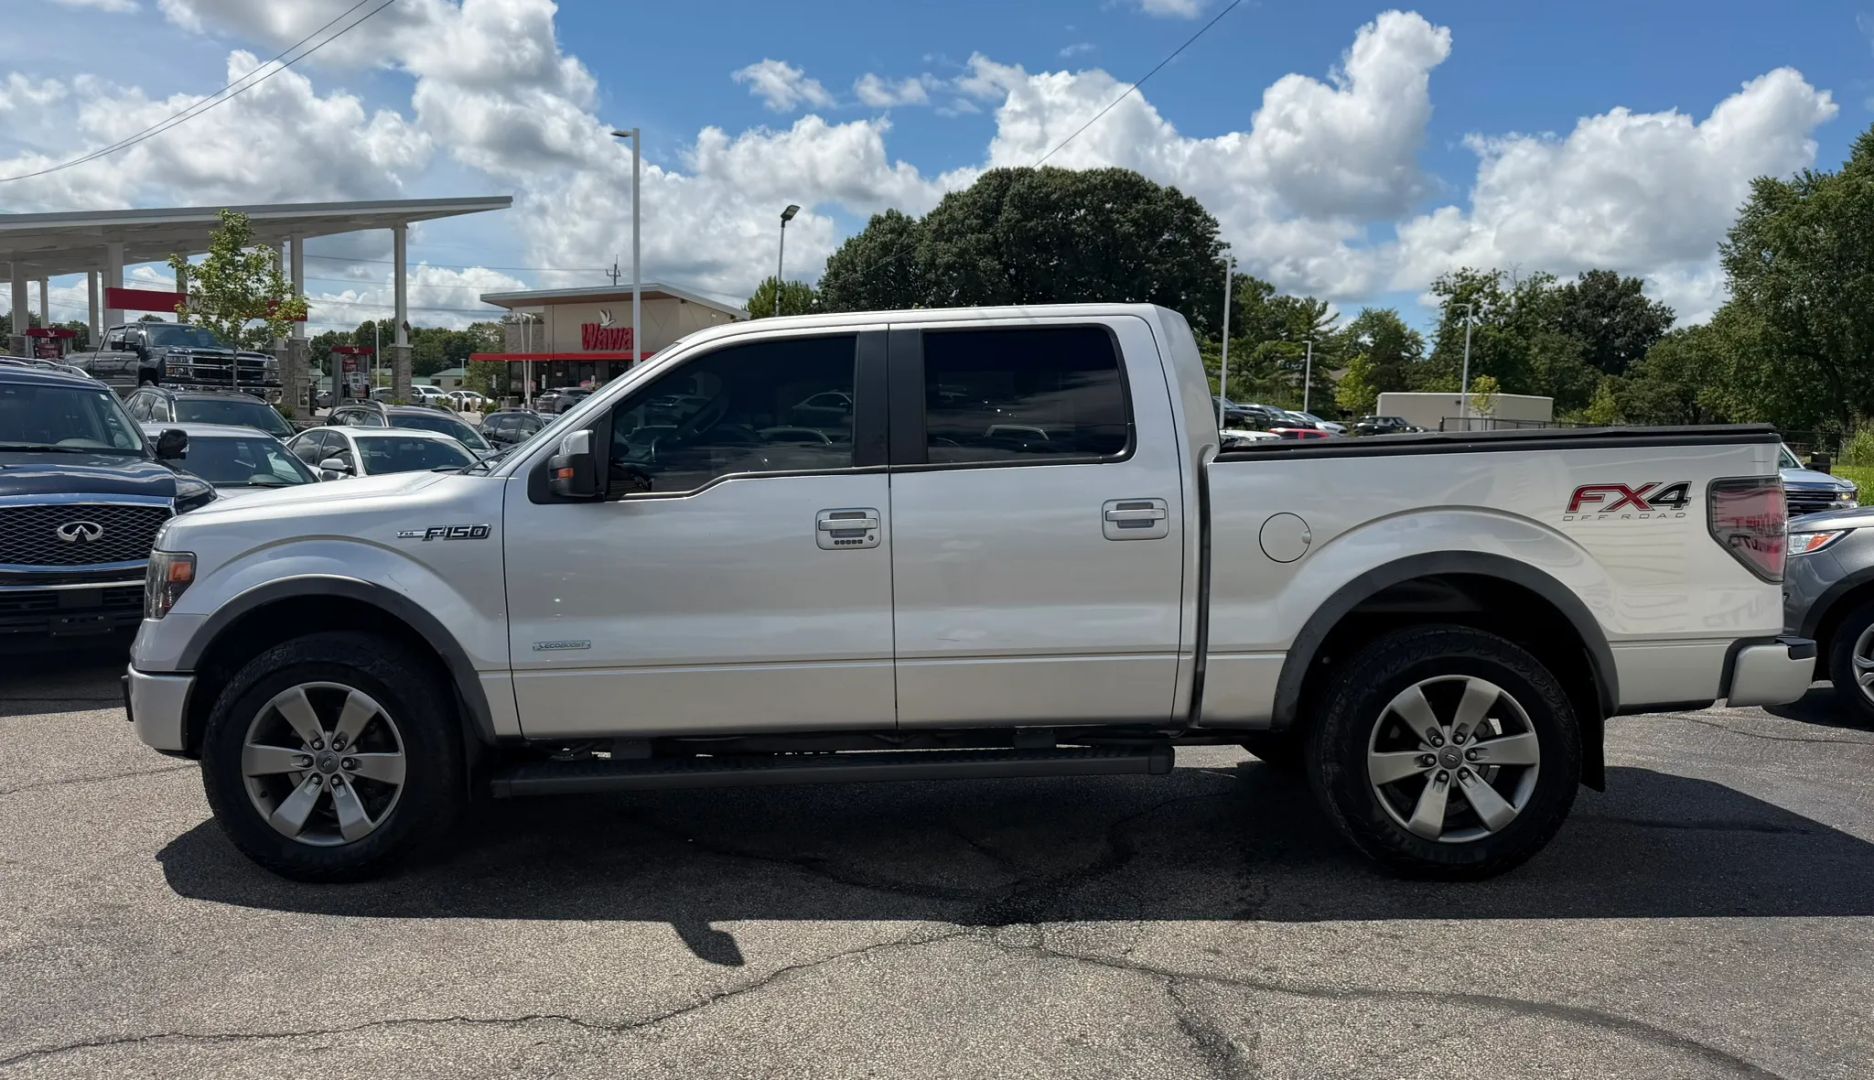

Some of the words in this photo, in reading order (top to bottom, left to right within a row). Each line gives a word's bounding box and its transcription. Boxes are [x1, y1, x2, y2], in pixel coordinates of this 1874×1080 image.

[581, 322, 634, 351] Wawa
[1565, 481, 1692, 513] FX4
[1620, 512, 1687, 520] ROAD
